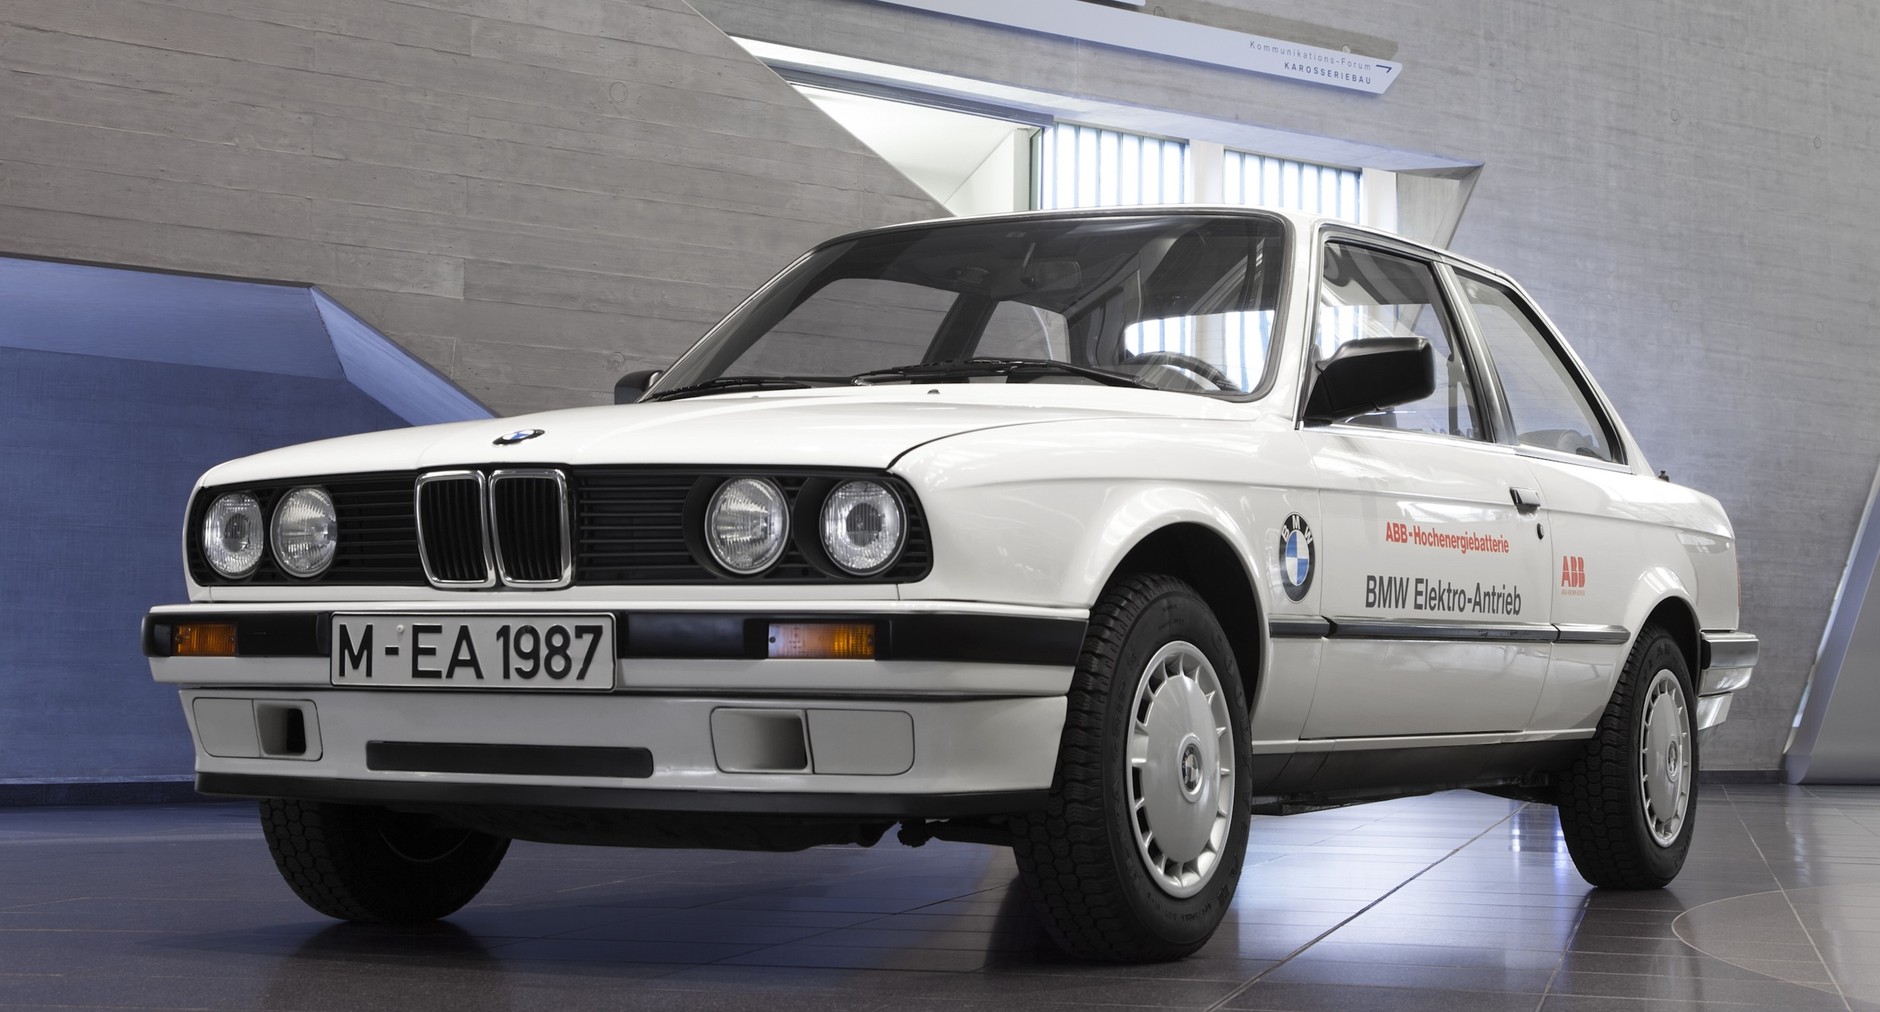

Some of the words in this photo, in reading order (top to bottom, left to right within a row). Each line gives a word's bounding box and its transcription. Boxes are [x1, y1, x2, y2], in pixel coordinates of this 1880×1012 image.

[1250, 40, 1371, 71] Kommunikations-Forum
[1284, 62, 1371, 85] KAROSSERIEBAU
[1281, 514, 1313, 545] BMW
[1385, 521, 1509, 554] ABB-Hochenergiebatterie
[1561, 555, 1585, 588] ABB
[1365, 574, 1410, 609] BMW
[1413, 578, 1521, 616] Elektro-Antrieb
[496, 624, 603, 680] 1987
